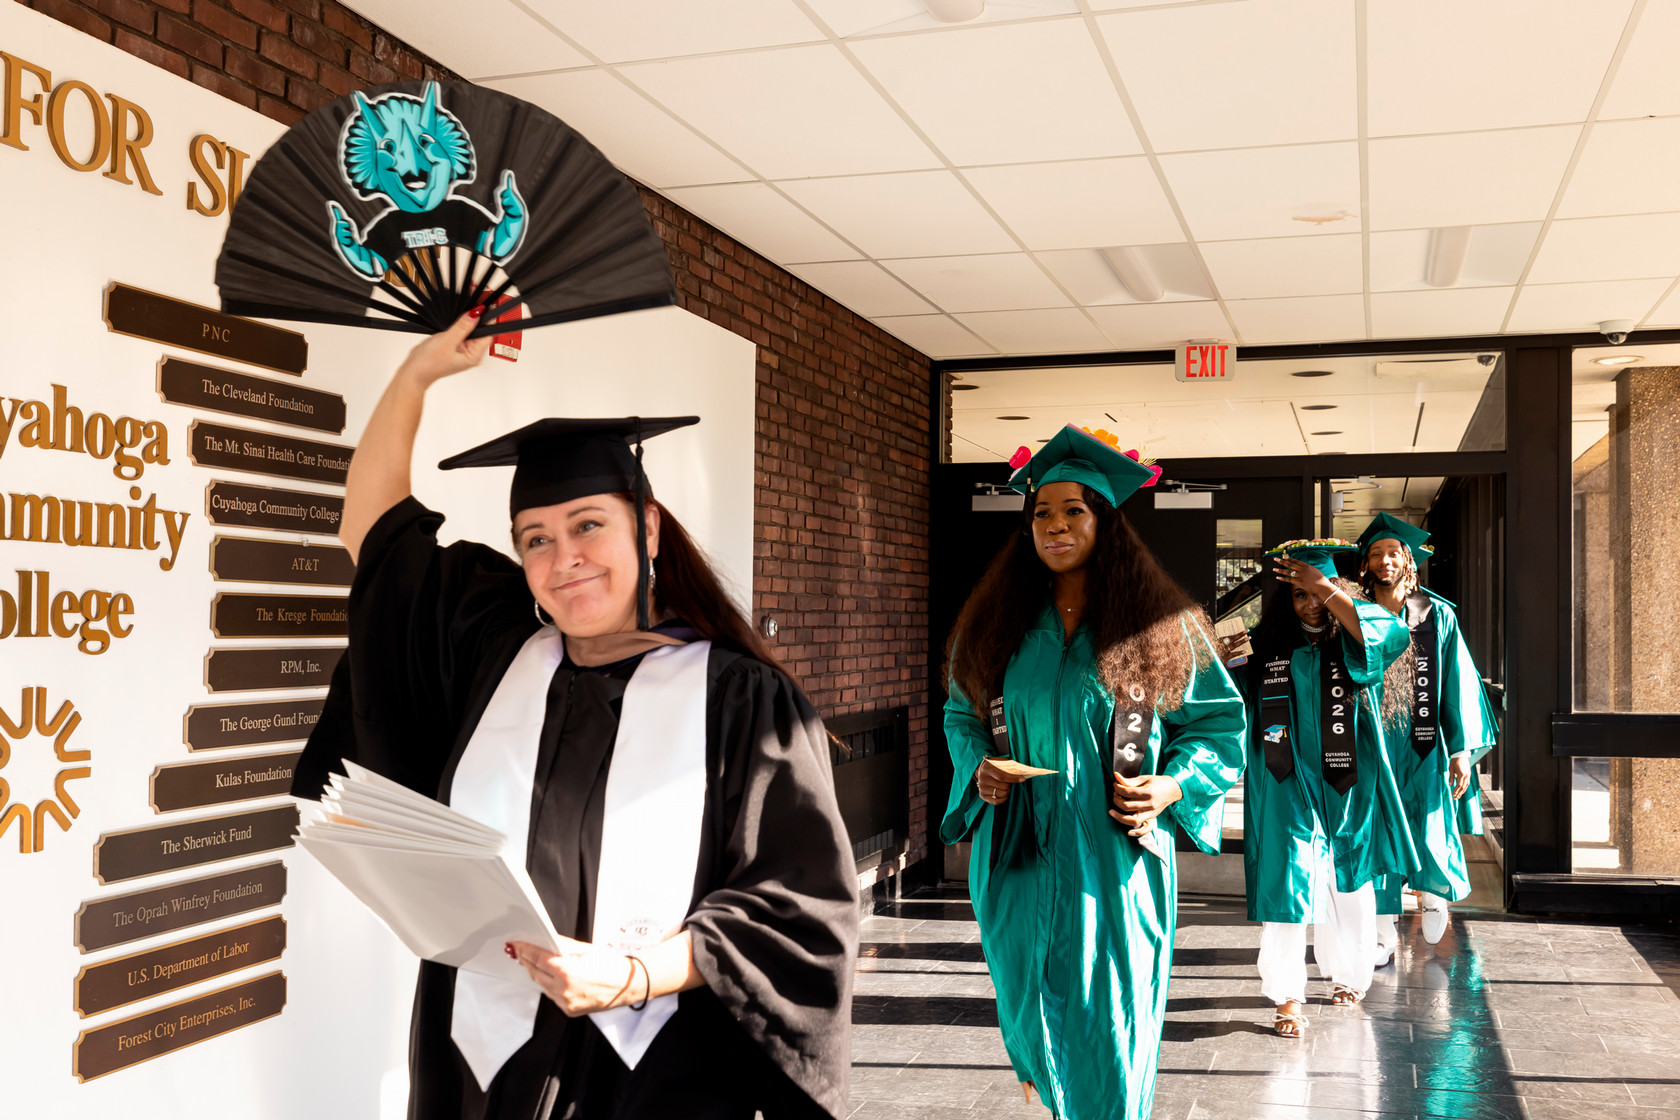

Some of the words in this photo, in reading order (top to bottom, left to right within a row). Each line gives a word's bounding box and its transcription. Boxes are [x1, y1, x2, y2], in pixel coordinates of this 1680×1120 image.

[0, 51, 163, 195] FOR
[202, 322, 231, 343] PNC
[1186, 345, 1229, 377] EXIT
[202, 379, 221, 396] The
[222, 384, 267, 405] Cleveland
[268, 392, 314, 414] Foundation
[204, 436, 223, 452] The
[225, 440, 241, 456] Mt.
[243, 443, 266, 459] Sinai
[268, 446, 295, 463] Health
[296, 451, 316, 466] Care
[212, 494, 258, 515] Cuyahoga
[259, 499, 308, 520] Community
[309, 506, 340, 524] College
[0, 486, 191, 571] munity
[291, 557, 320, 572] AT&T
[256, 608, 274, 621] The
[278, 608, 307, 625] Kresge
[281, 660, 305, 676] RPM,
[306, 659, 322, 673] Inc.
[1417, 661, 1430, 718] 2026
[220, 717, 238, 732] The
[239, 715, 271, 734] George
[273, 712, 297, 728] Gund
[1123, 684, 1146, 762] 026
[215, 772, 242, 788] Kulas
[244, 766, 292, 785] Foundation
[161, 838, 181, 855] The
[183, 829, 227, 852] Sherwick
[229, 826, 252, 842] Fund
[112, 911, 135, 928] The
[136, 901, 169, 925] Oprah
[171, 894, 211, 914] Winfrey
[212, 881, 263, 904] Foundation
[128, 968, 150, 986] U.S.
[153, 953, 209, 979] Department
[210, 944, 222, 962] of
[223, 942, 250, 959] Labor
[118, 1029, 152, 1051] Forest
[154, 1017, 177, 1042] City
[179, 1004, 237, 1032] Enterprises,
[239, 994, 257, 1011] Inc.
